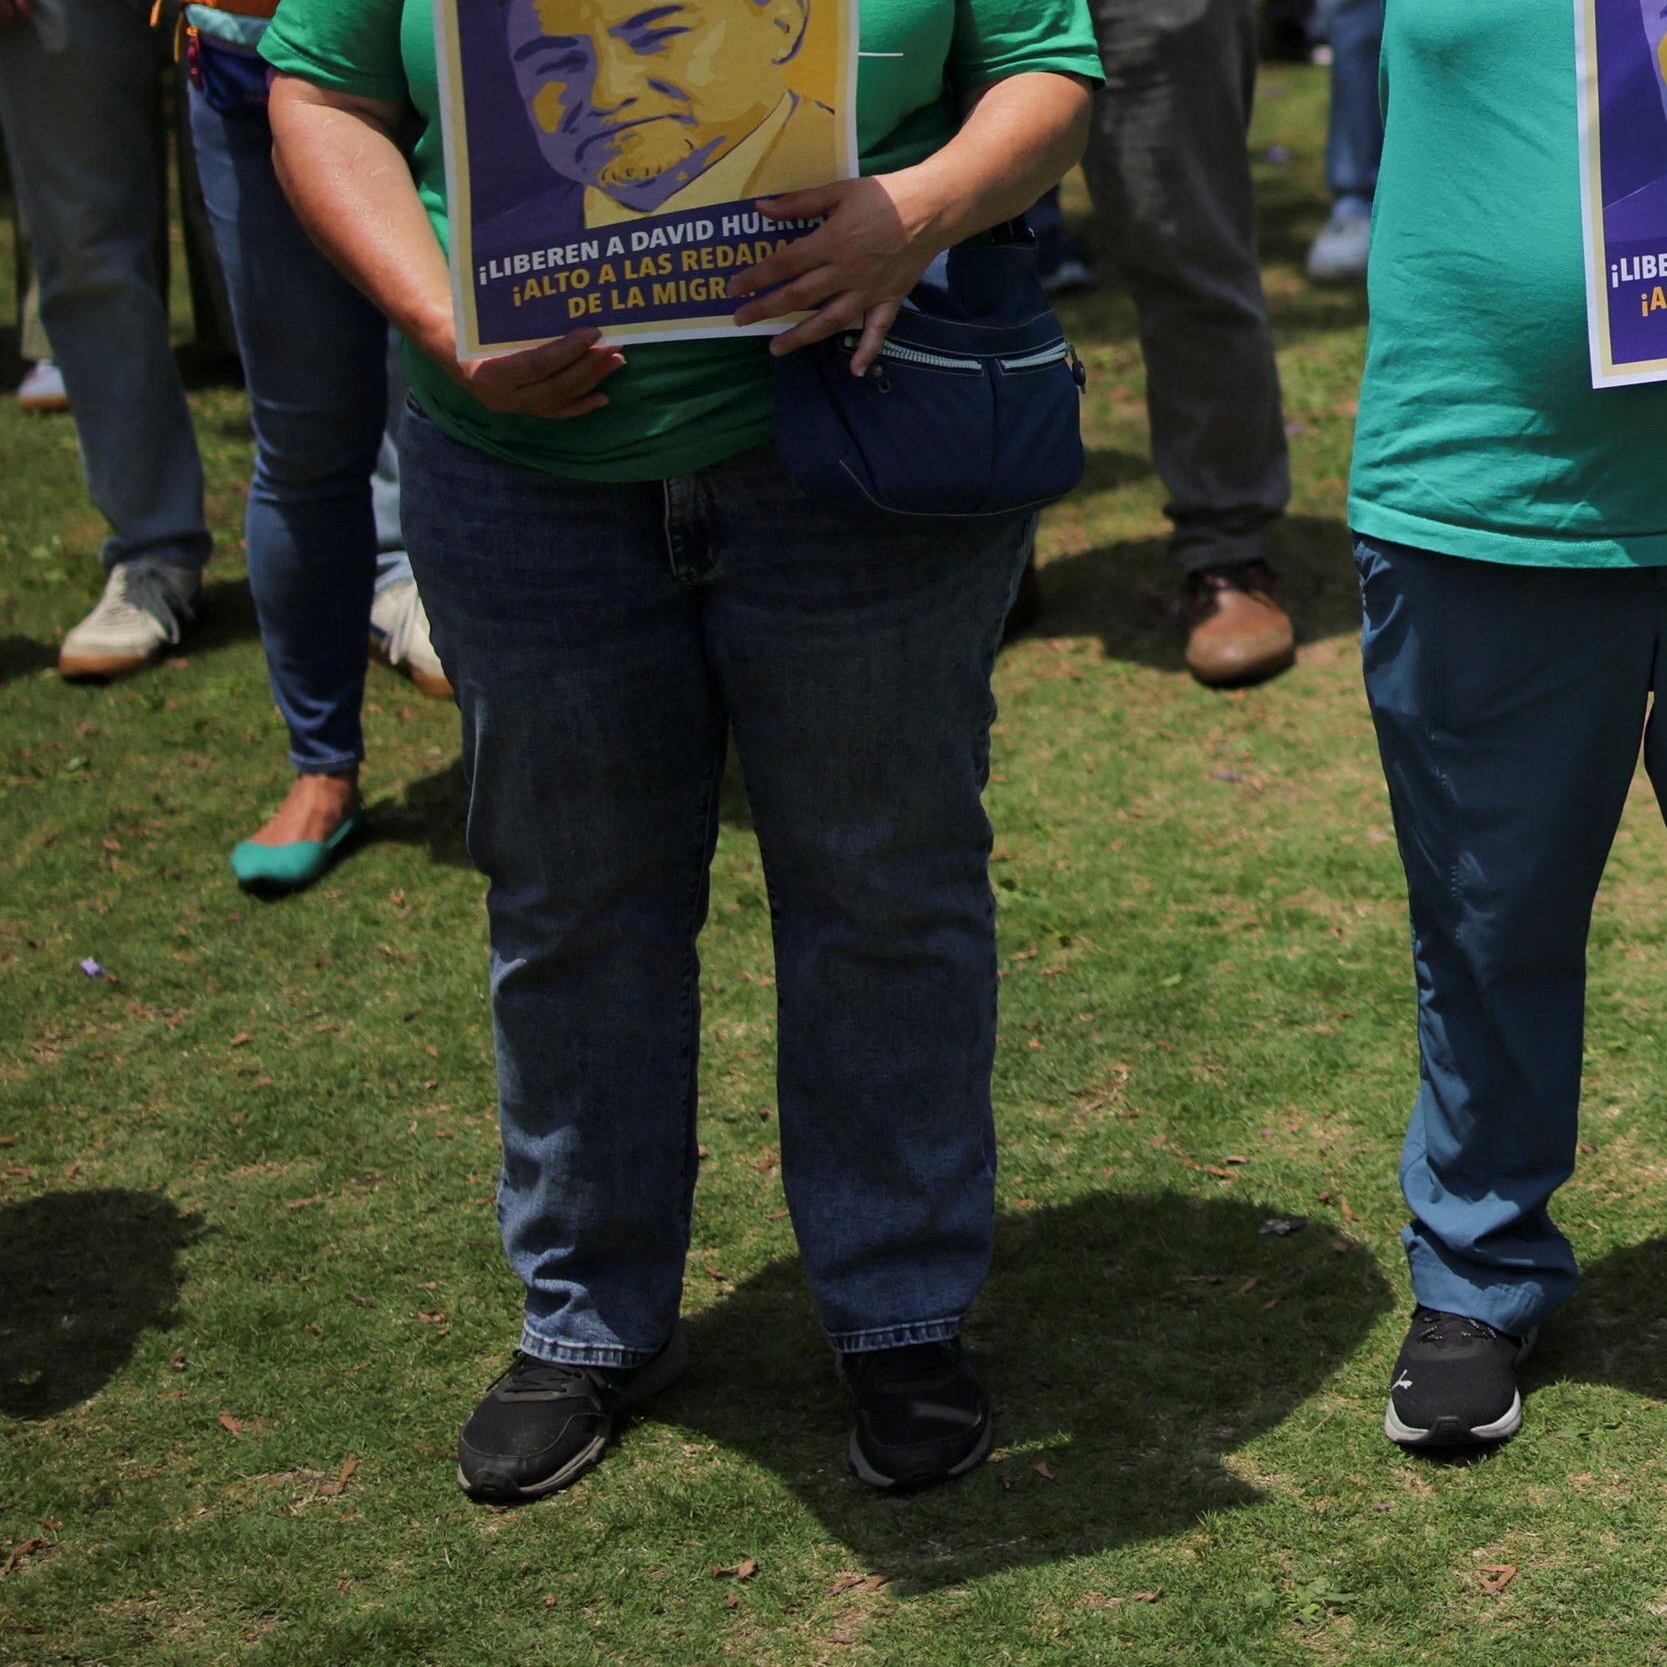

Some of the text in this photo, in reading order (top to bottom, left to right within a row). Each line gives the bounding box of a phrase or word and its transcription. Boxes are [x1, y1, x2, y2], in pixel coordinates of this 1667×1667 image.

[478, 240, 600, 285] ¡LIBEREN
[606, 236, 626, 257] A
[630, 219, 714, 253] DAVID
[512, 269, 591, 307] ¡ALTO
[597, 263, 617, 284] A
[624, 251, 674, 281] LAS
[567, 295, 603, 320] DE
[610, 287, 645, 311] LA
